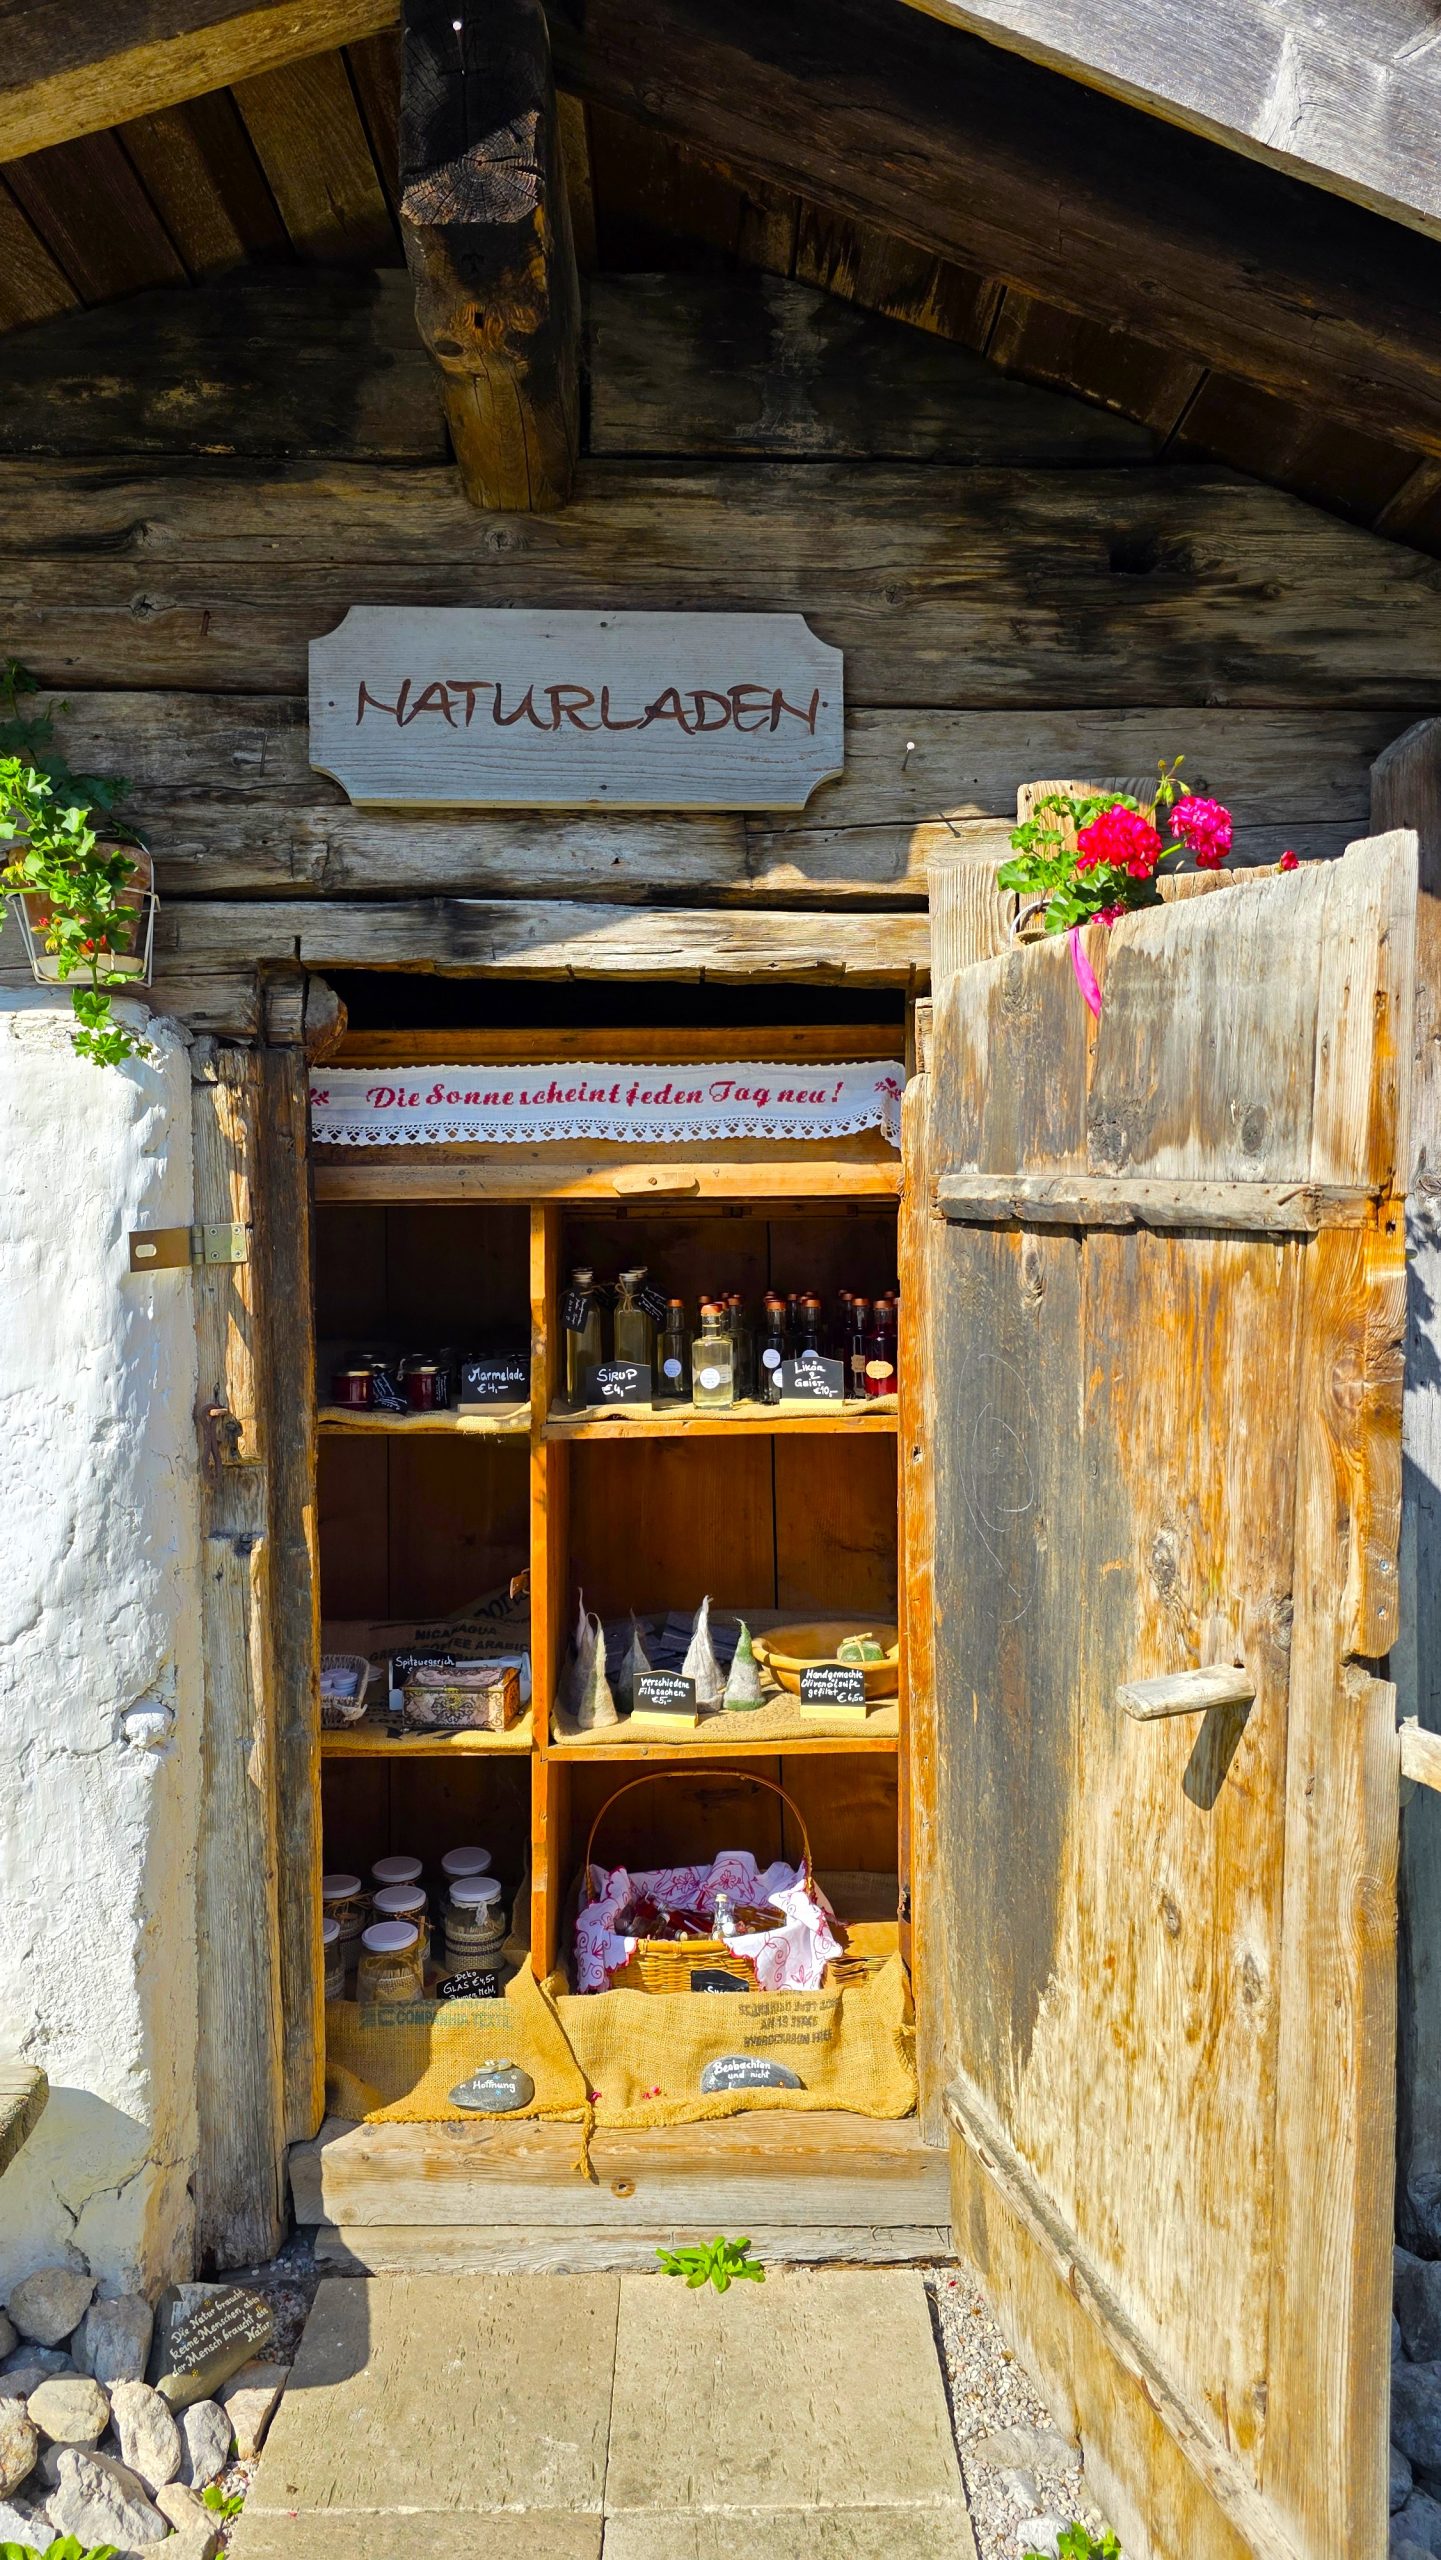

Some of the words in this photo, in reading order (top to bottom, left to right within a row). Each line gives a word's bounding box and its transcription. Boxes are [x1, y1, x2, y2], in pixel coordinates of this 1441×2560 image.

[356, 678, 820, 735] NATURLADEN
[366, 1087, 420, 1108] Die
[425, 1084, 515, 1105] Sonne
[519, 1081, 621, 1105] scheint
[626, 1081, 704, 1107] jeden
[709, 1080, 772, 1107] Tag
[468, 1366, 526, 1382] Marmelade
[395, 1654, 455, 1669] Spitzwegerich
[806, 1669, 864, 1681] Handgemachte
[454, 1971, 477, 1983] Deko
[713, 2059, 771, 2075] Beobachten
[727, 2070, 745, 2079] und
[750, 2070, 770, 2079] nicht
[472, 2079, 516, 2093] Hoffnung
[171, 2327, 190, 2343] Die
[189, 2308, 215, 2329] Natur
[215, 2288, 246, 2311] braucht
[169, 2336, 200, 2360] keine
[243, 2296, 261, 2309] aber
[244, 2321, 270, 2342] Natur
[172, 2363, 186, 2378] der
[185, 2336, 223, 2367] Mensch
[222, 2313, 254, 2341] braucht
[256, 2306, 269, 2319] die
